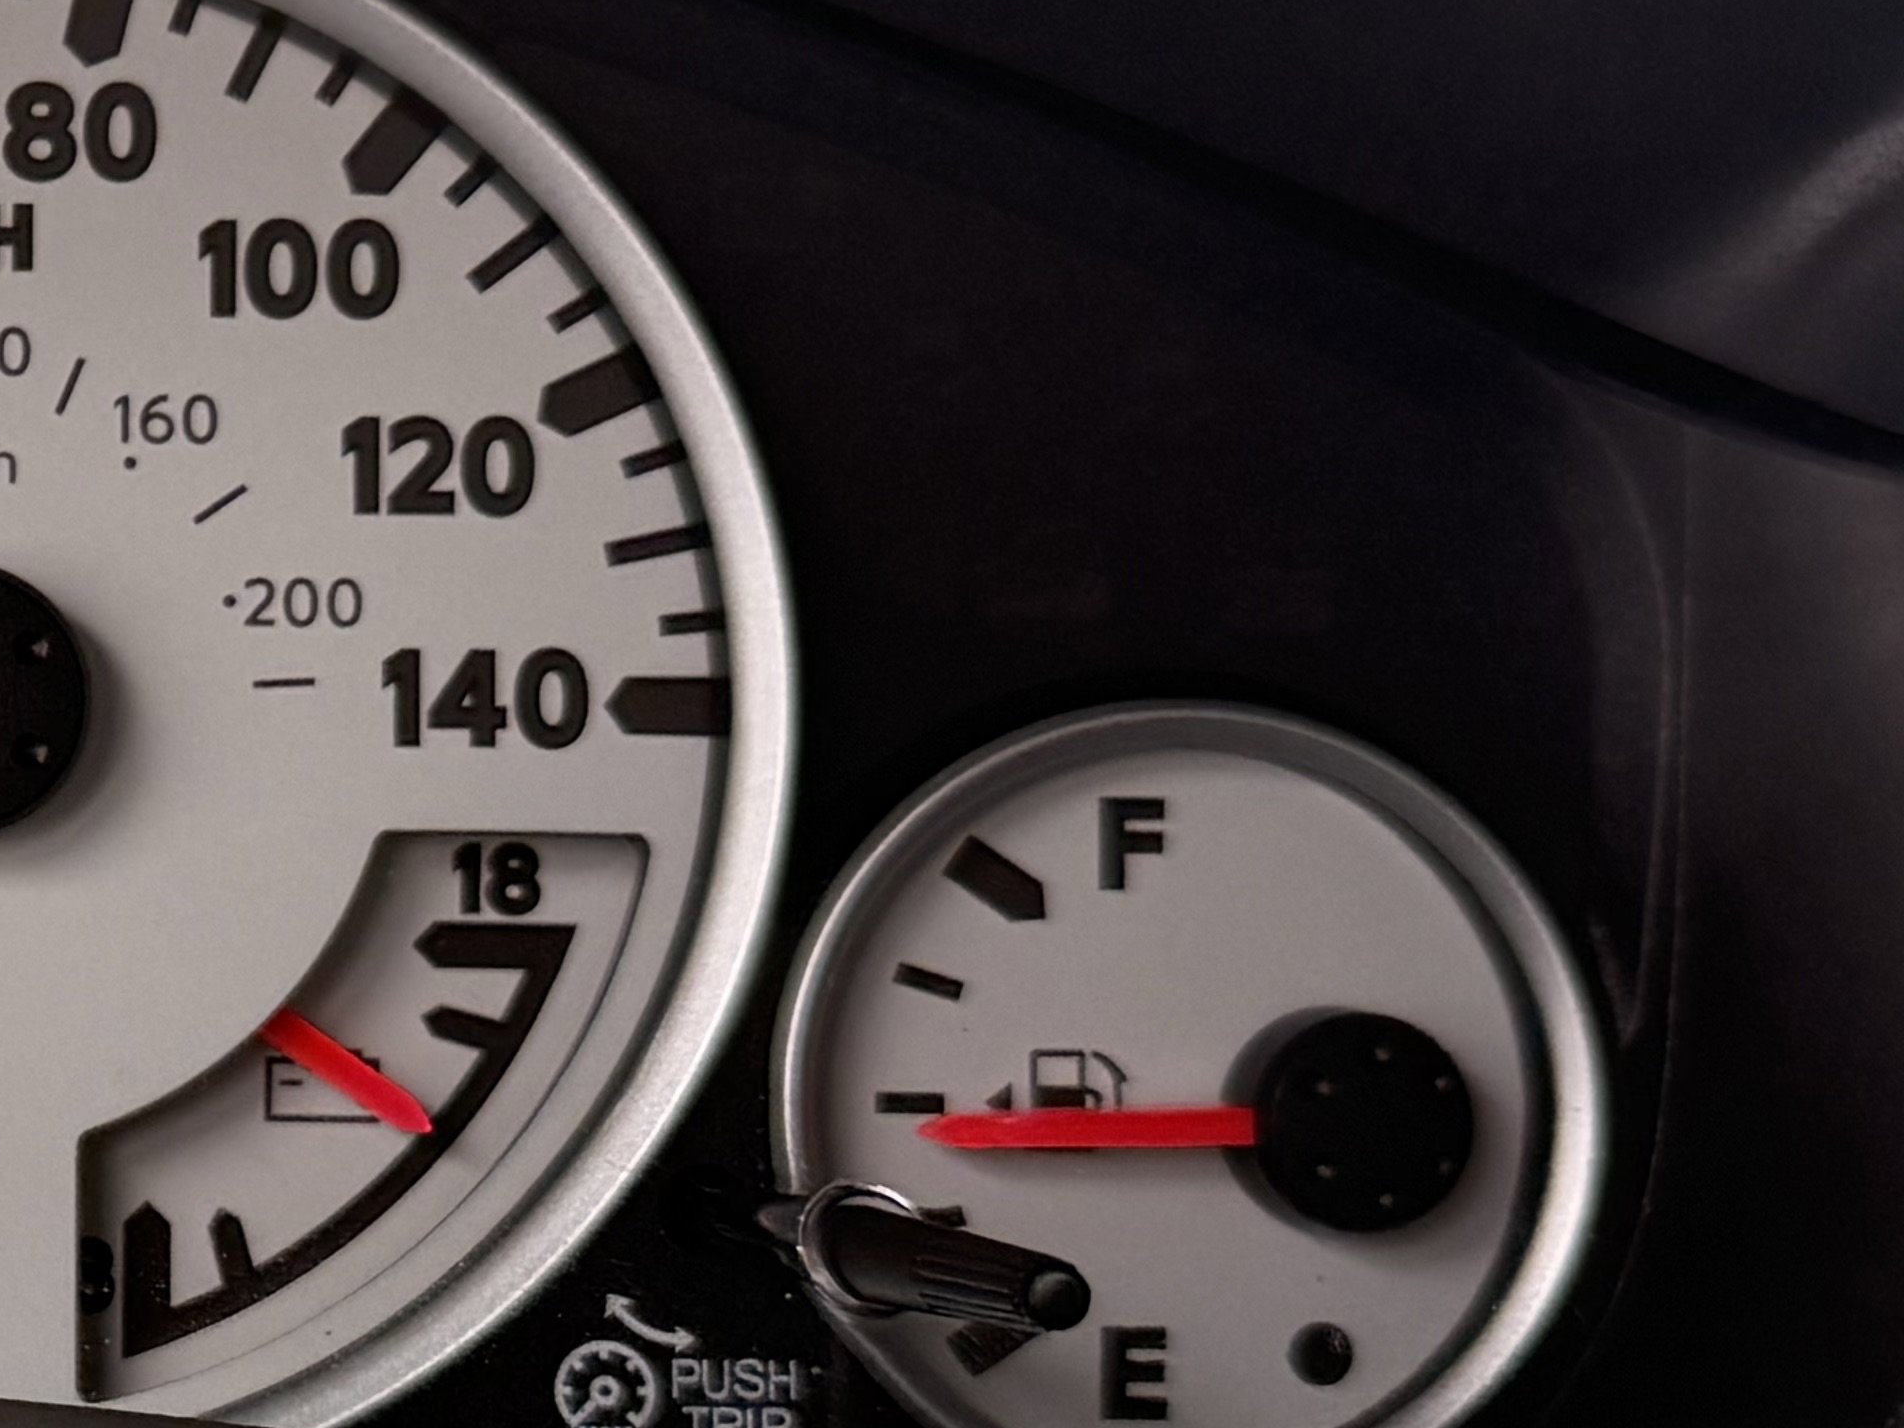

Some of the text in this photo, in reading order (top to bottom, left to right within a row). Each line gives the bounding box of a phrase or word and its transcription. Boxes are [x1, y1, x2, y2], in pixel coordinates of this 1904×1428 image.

[2, 81, 157, 182] 80
[198, 218, 401, 319] 100
[114, 394, 218, 444] 160
[342, 415, 535, 517] 120
[243, 578, 363, 628] 200
[382, 647, 589, 749] 140
[453, 841, 541, 915] 18
[1098, 797, 1165, 890] F
[672, 1358, 796, 1401] PUSH
[1100, 1327, 1167, 1421] E
